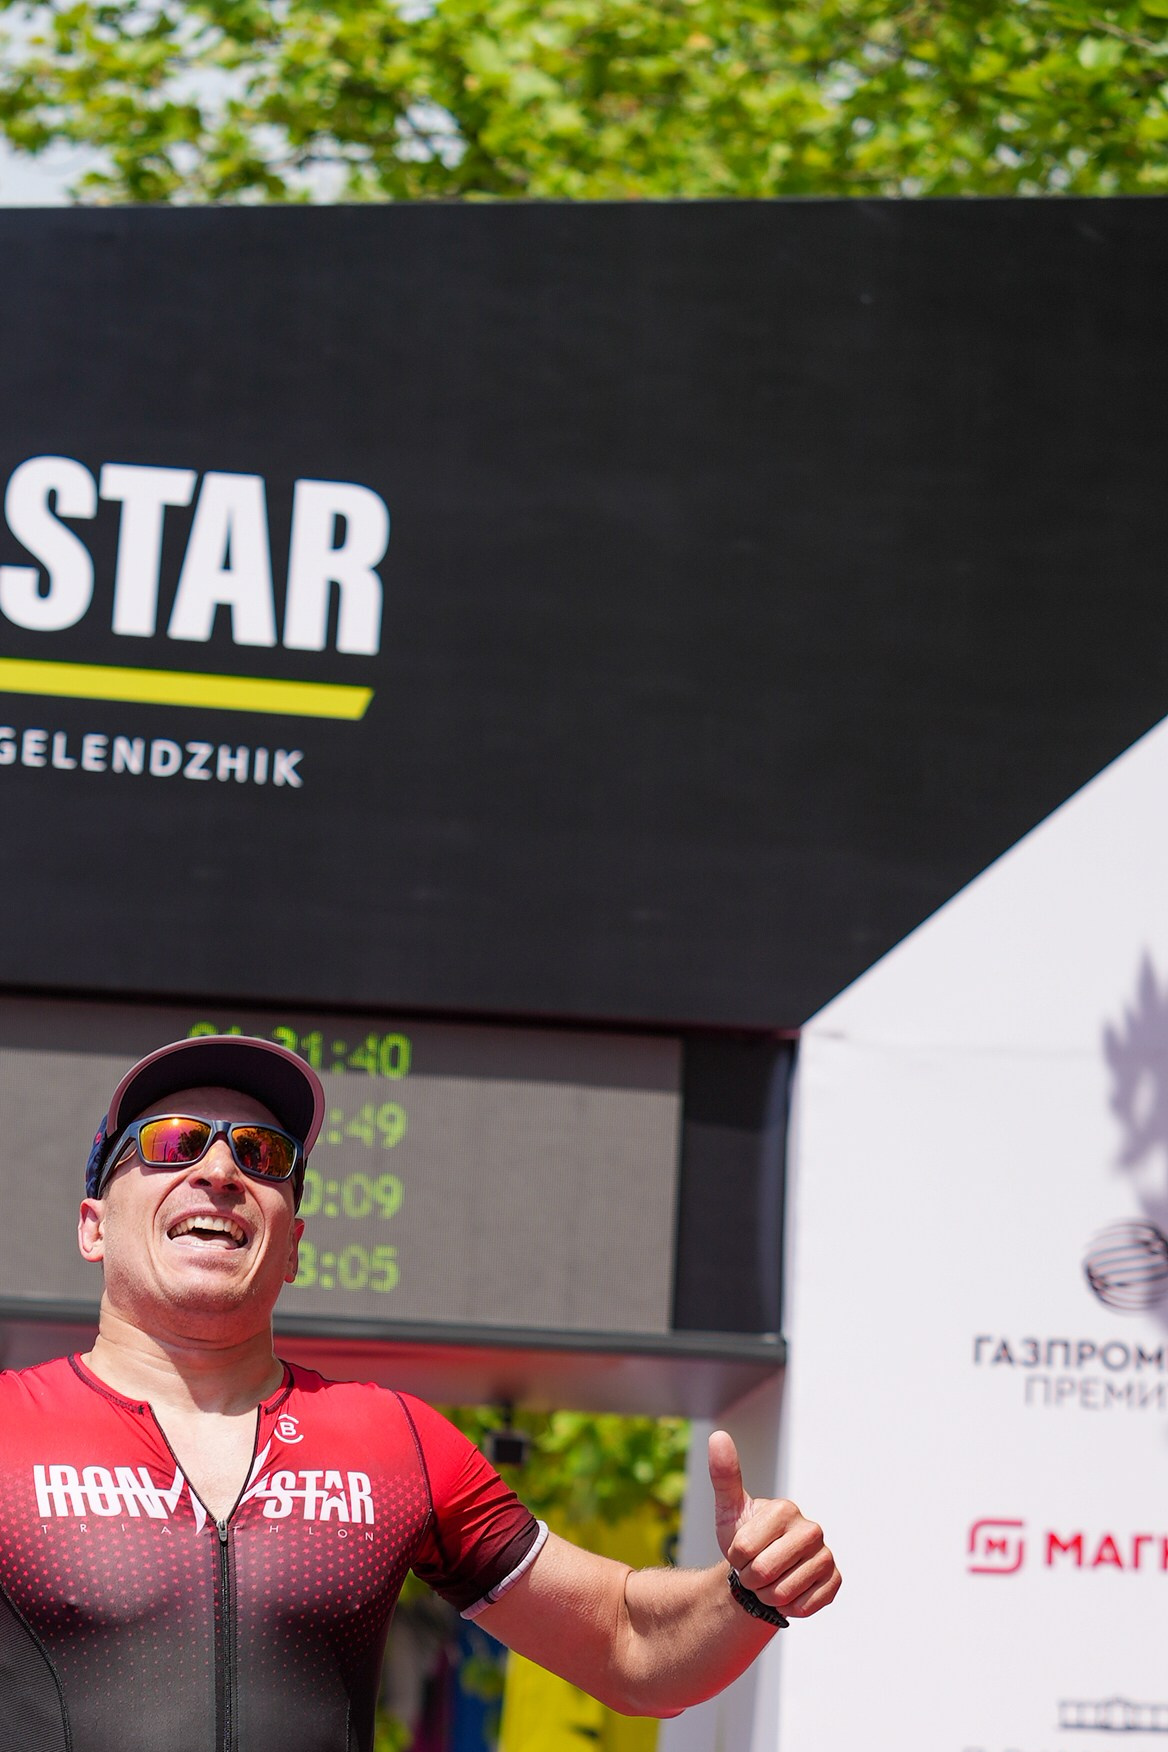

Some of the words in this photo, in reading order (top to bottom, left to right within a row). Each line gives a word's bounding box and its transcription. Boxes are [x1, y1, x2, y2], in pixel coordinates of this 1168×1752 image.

[33, 1464, 169, 1520] IRON
[262, 1469, 375, 1525] STAR
[1045, 1531, 1168, 1572] МАГ
